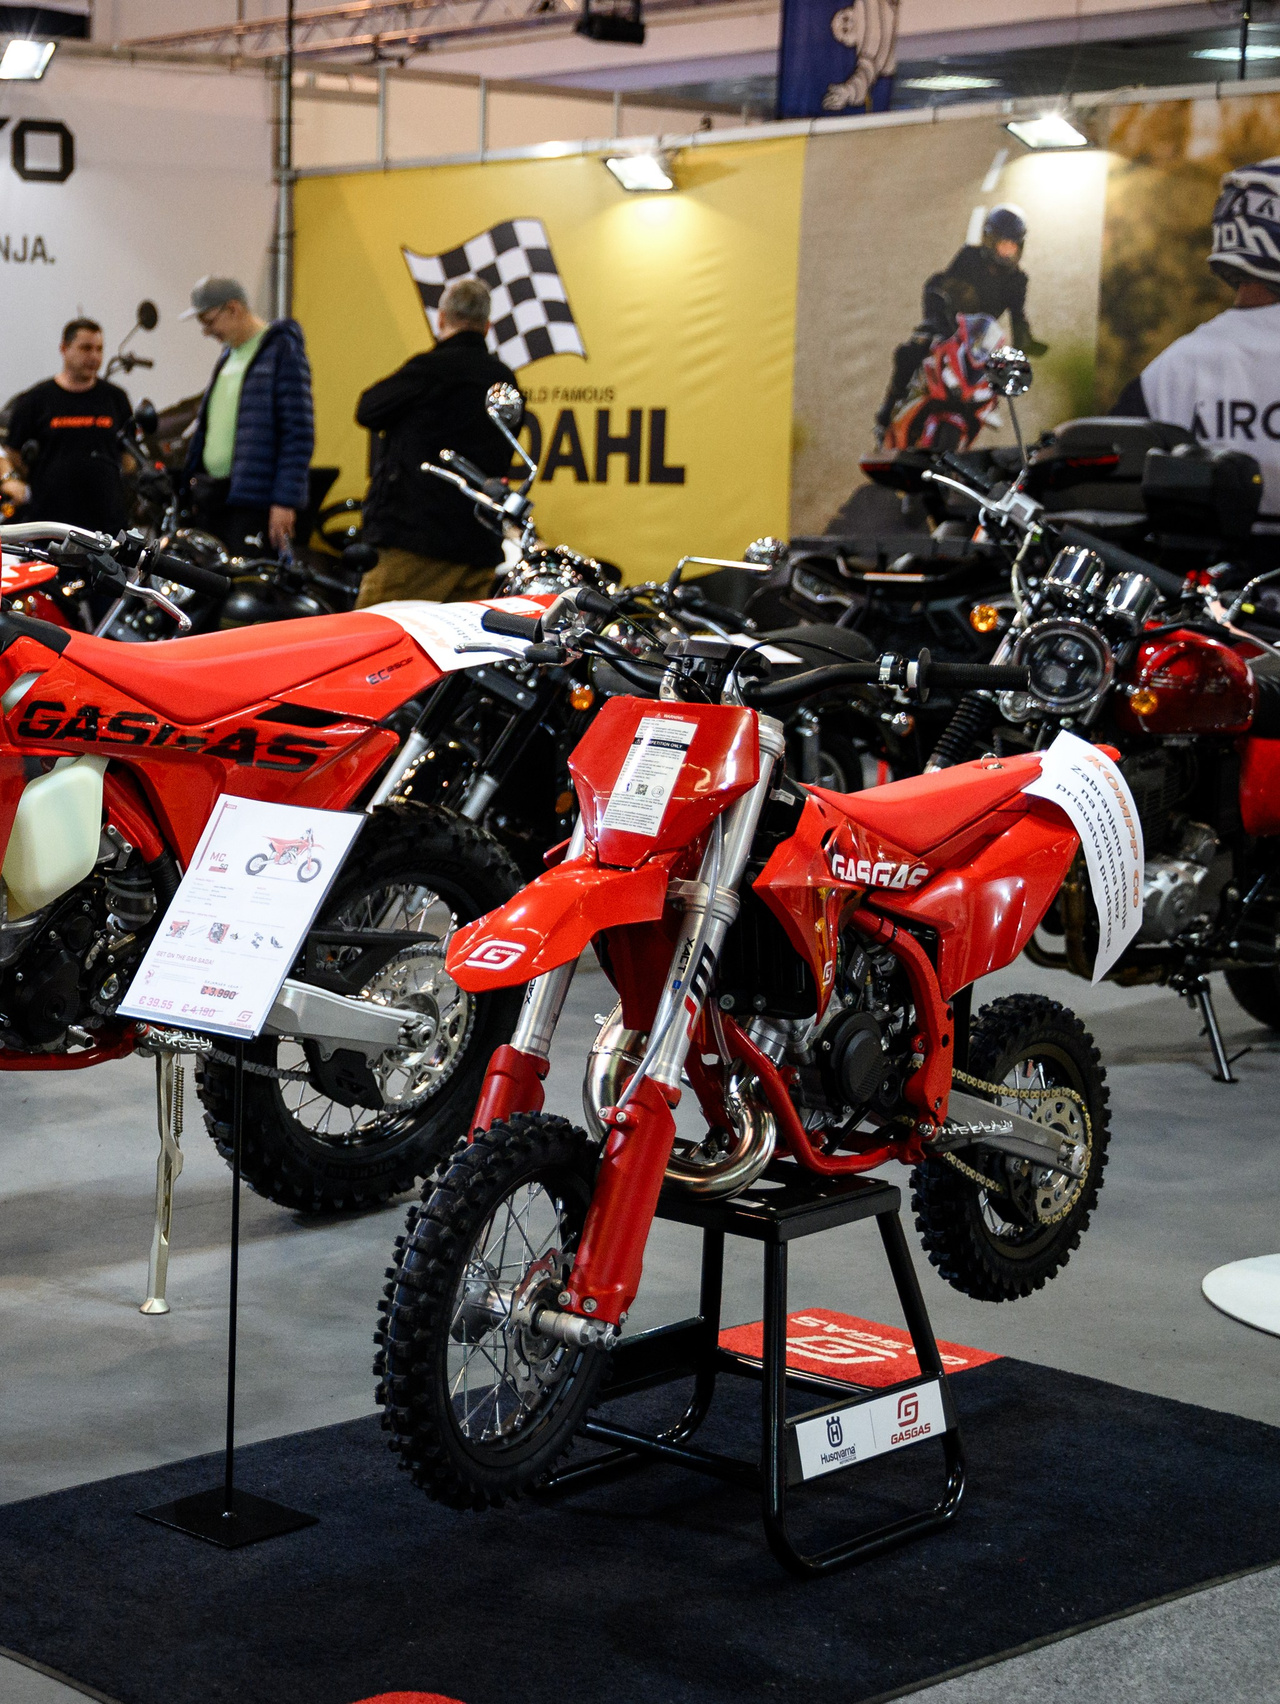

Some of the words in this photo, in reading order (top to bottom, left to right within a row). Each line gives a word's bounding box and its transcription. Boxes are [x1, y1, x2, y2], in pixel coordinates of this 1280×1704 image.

[551, 385, 614, 402] FAMOUS
[1055, 783, 1102, 861] prisustva
[1081, 788, 1096, 810] na
[1096, 813, 1117, 887] vozilima
[1082, 754, 1138, 861] KOMPP
[1132, 869, 1139, 908] CO
[210, 851, 227, 862] MC
[832, 854, 929, 889] GASGAS
[148, 997, 174, 1010] 39.55
[190, 1005, 216, 1018] 4.190
[820, 1444, 856, 1465] Husqvarna
[891, 1423, 931, 1445] GASGAS
